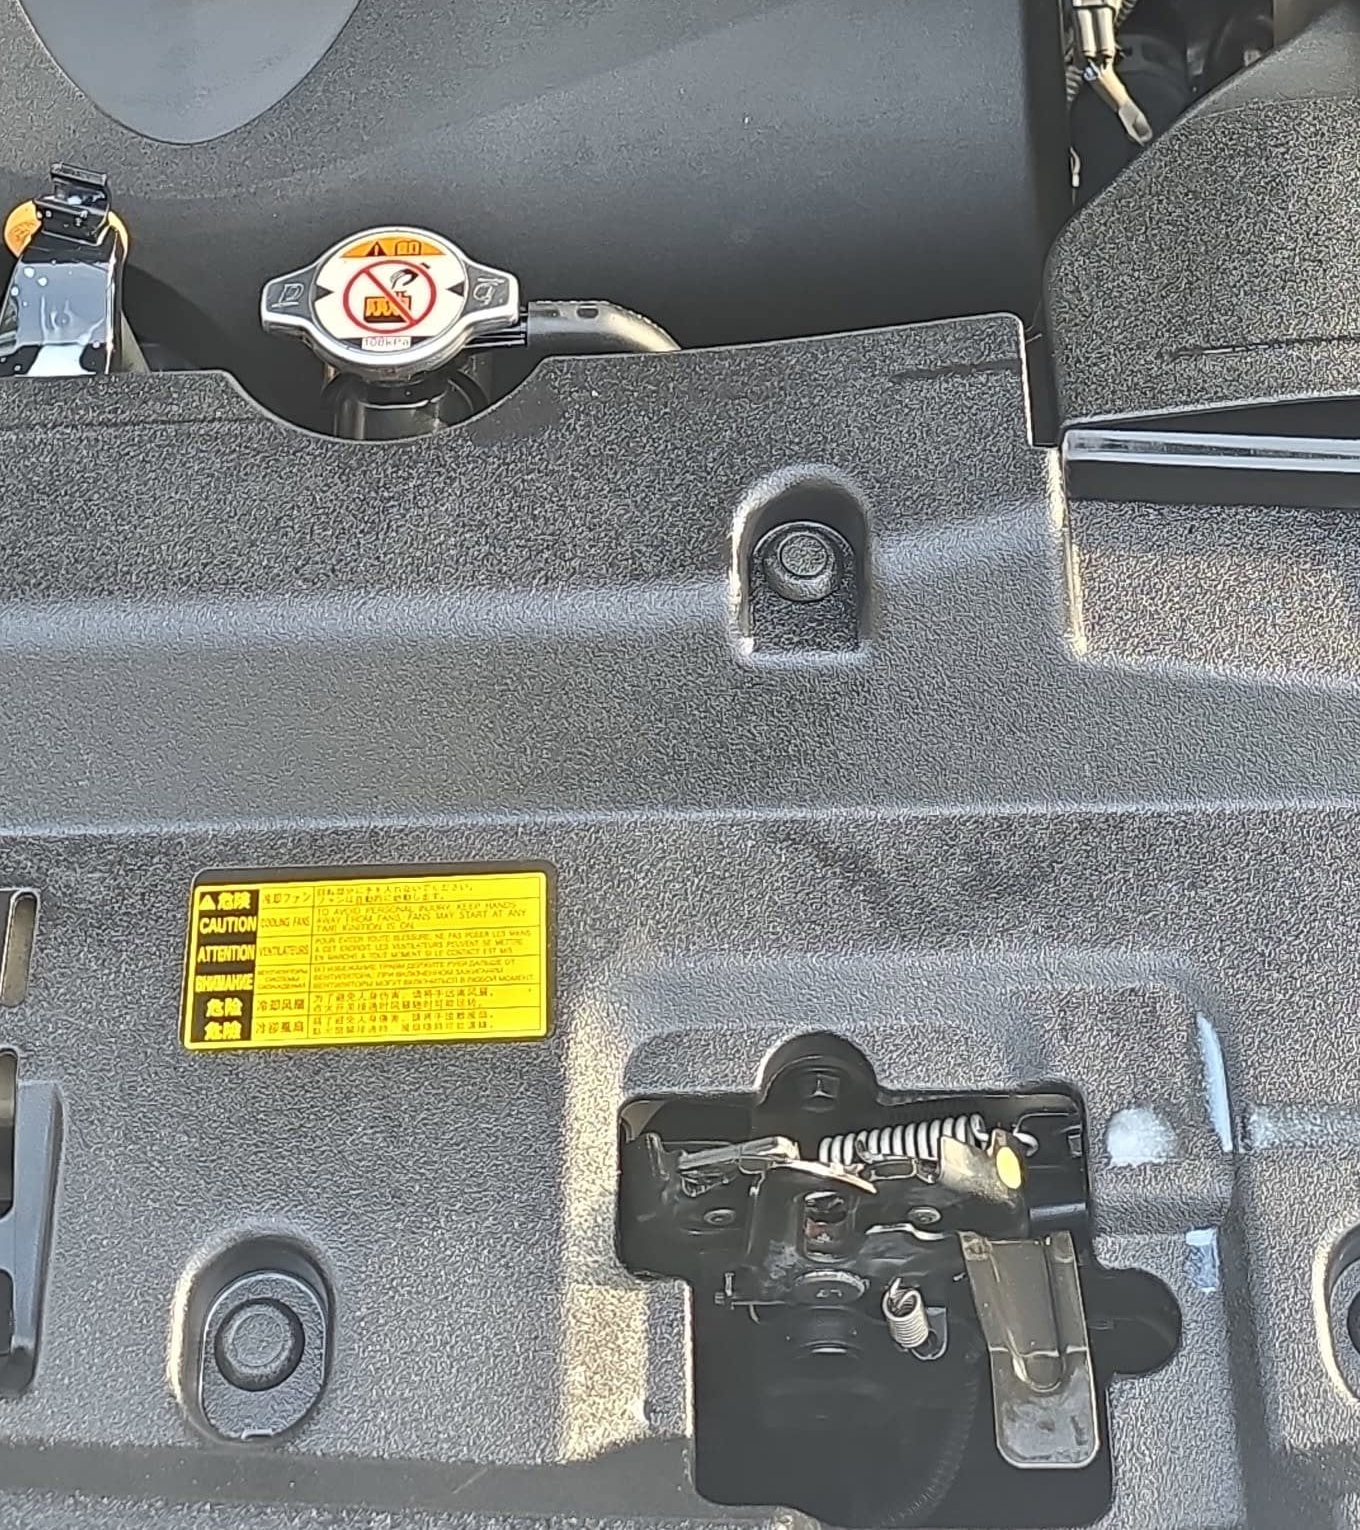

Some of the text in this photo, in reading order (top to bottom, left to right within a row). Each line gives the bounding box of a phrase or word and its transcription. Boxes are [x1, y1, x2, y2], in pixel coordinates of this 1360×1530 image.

[456, 902, 481, 911] KEEP
[485, 901, 516, 910] HANDS
[261, 916, 311, 929] COOLING FANS
[407, 912, 431, 921] FANS
[436, 911, 455, 920] MAY
[459, 910, 489, 919] START
[492, 910, 505, 918] AT
[508, 909, 527, 918] ANY
[199, 915, 257, 934] CAUTION
[197, 944, 256, 963] ATTENTION
[195, 973, 254, 993] ВНИМАНИЕ
